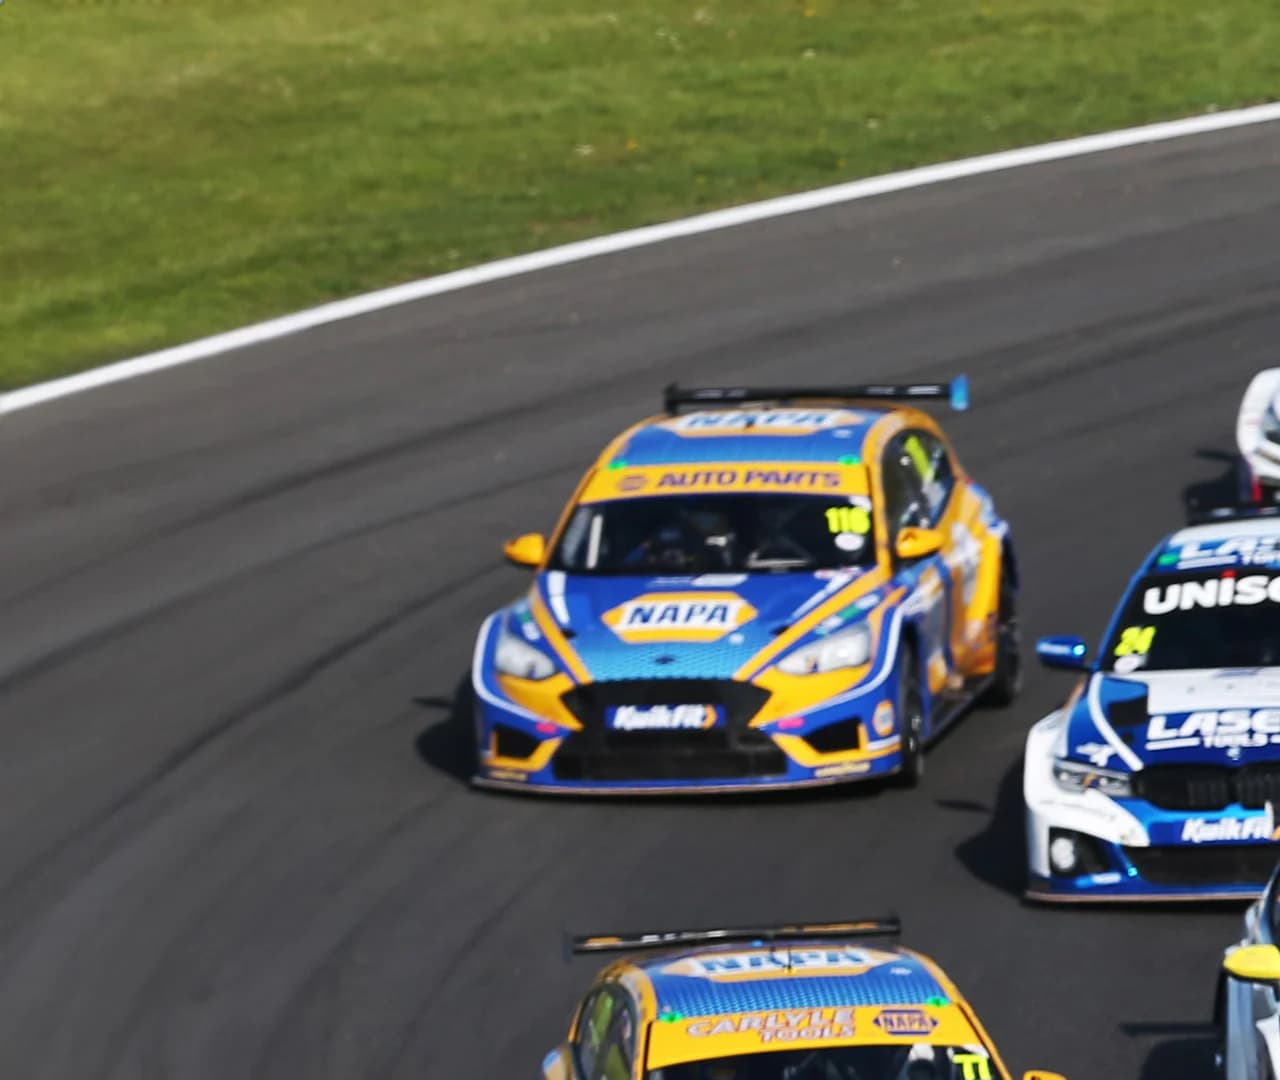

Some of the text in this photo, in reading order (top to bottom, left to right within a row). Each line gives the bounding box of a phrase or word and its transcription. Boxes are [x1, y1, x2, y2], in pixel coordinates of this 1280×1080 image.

[658, 471, 840, 487] AUTO PARTS
[825, 507, 871, 535] 116
[627, 604, 728, 625] NAPA
[613, 704, 705, 731] KwikFit
[1203, 733, 1269, 748] TOOLS
[687, 1007, 855, 1036] CARLYLE
[882, 1013, 930, 1030] NAPA
[758, 1024, 855, 1042] TOOLS
